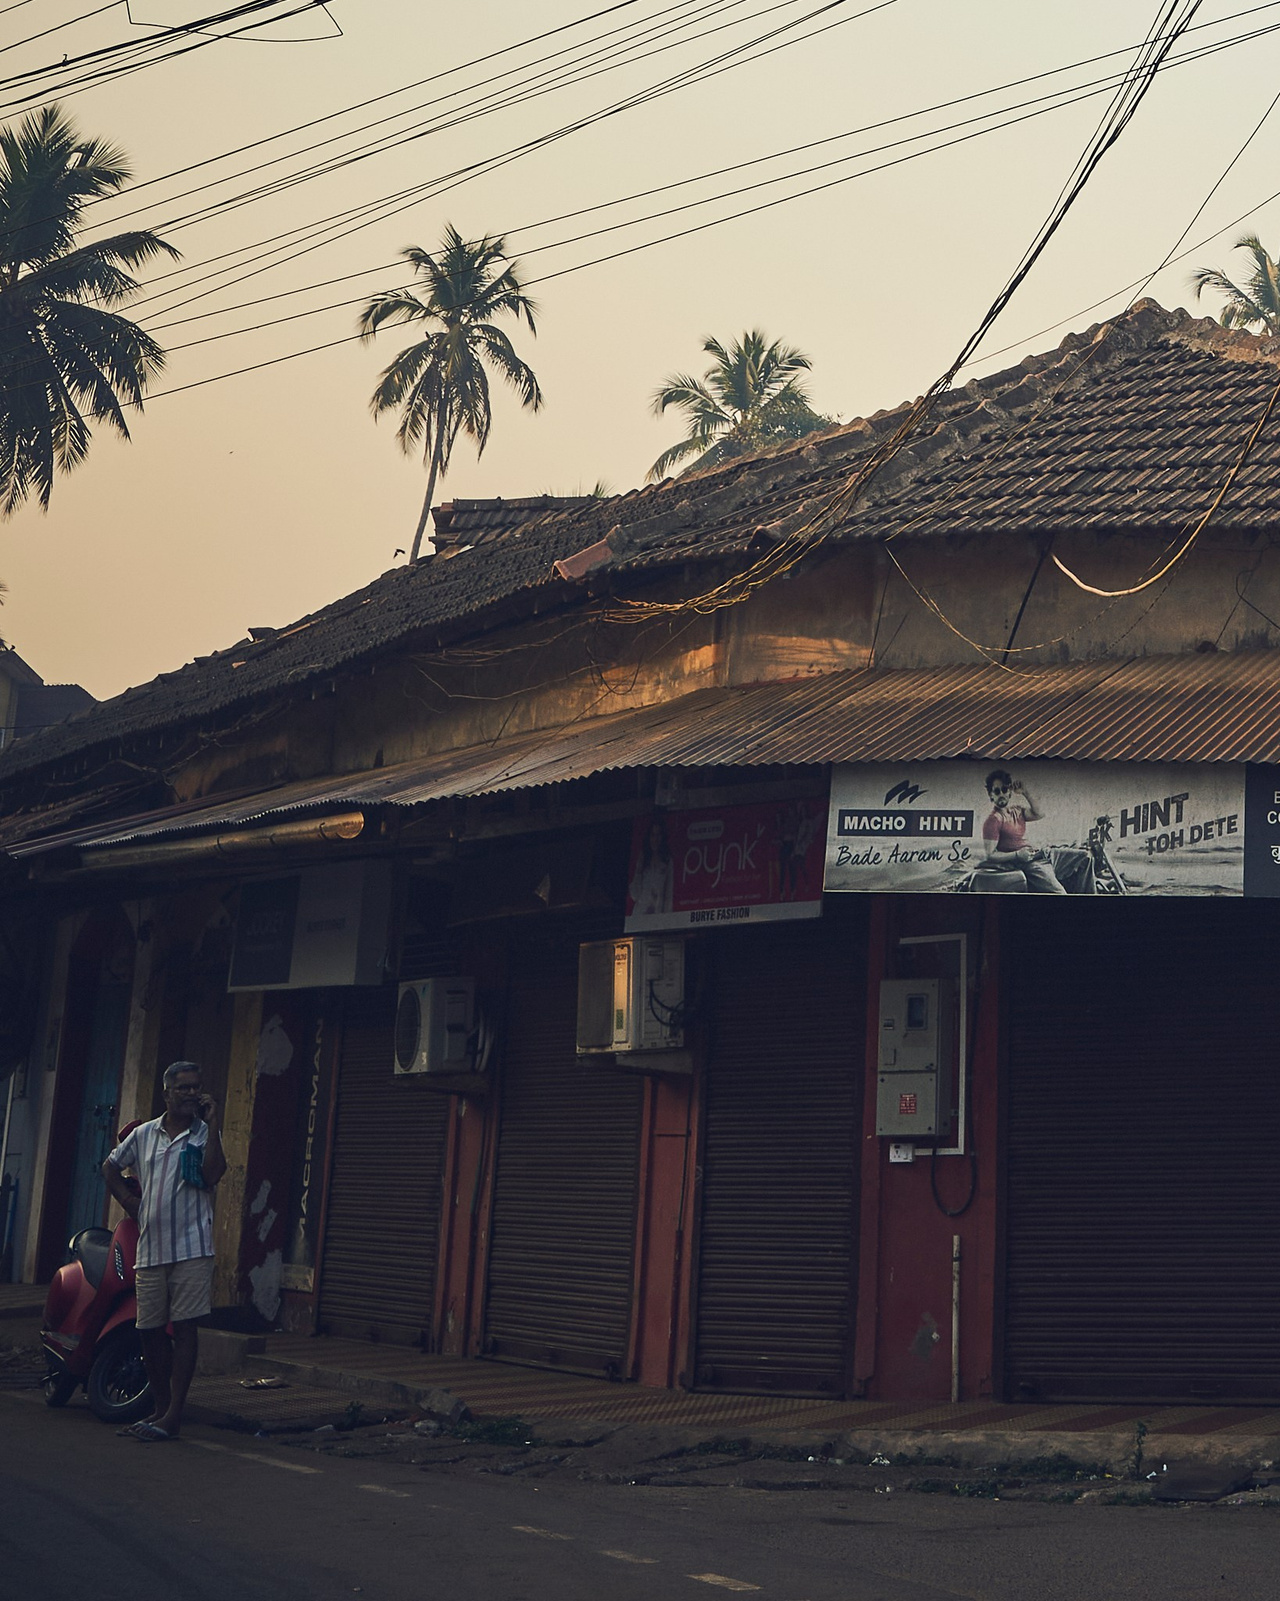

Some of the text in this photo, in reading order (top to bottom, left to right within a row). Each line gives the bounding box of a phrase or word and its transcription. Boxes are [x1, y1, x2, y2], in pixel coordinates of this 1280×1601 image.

[843, 815, 966, 831] MACHO HINT
[1120, 792, 1189, 838] HINT
[1147, 814, 1238, 855] TOH DETE
[836, 840, 972, 867] Bade Aaram Se
[690, 907, 750, 923] BURYE FASHION
